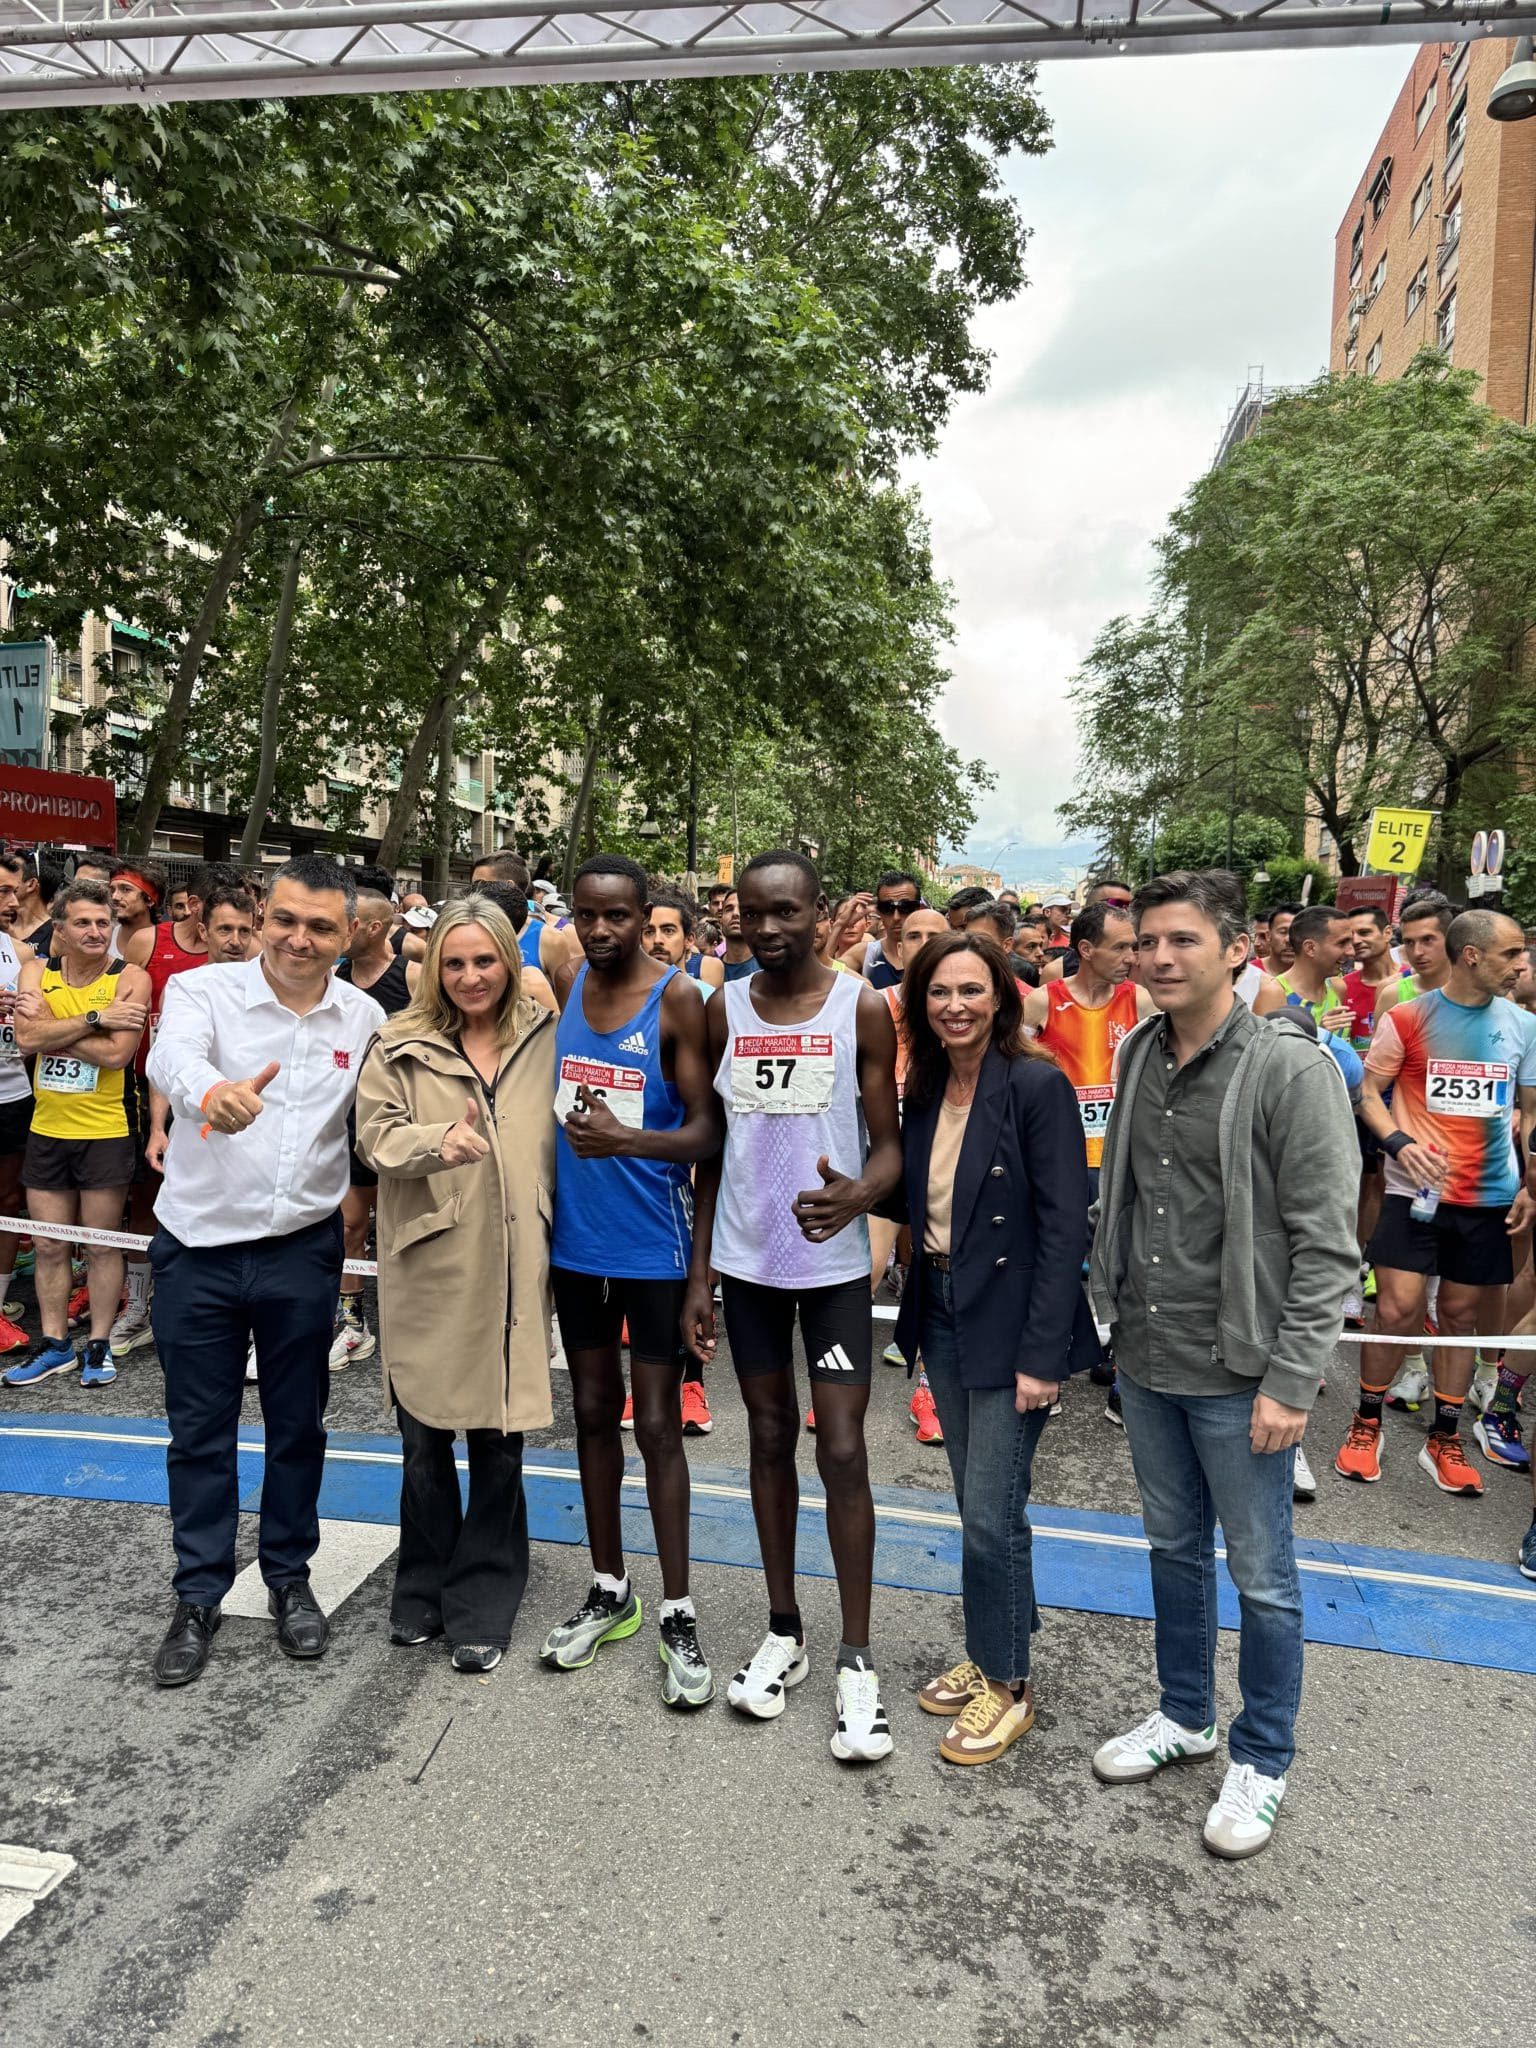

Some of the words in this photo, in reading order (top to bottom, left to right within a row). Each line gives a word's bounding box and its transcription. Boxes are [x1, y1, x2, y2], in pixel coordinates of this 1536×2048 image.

[0, 790, 101, 820] PROHIBIDO
[1378, 820, 1423, 838] ELITE
[1389, 841, 1406, 864] 2
[618, 1043, 649, 1056] adidas
[744, 1039, 763, 1047] MEDIA
[764, 1037, 796, 1047] MARATÓN
[44, 1057, 81, 1079] 253
[569, 1063, 584, 1074] MEDIA
[755, 1059, 797, 1090] 57
[588, 1075, 610, 1085] GRANADA
[1431, 1077, 1494, 1101] 2531
[32, 1224, 79, 1237] GRANADA
